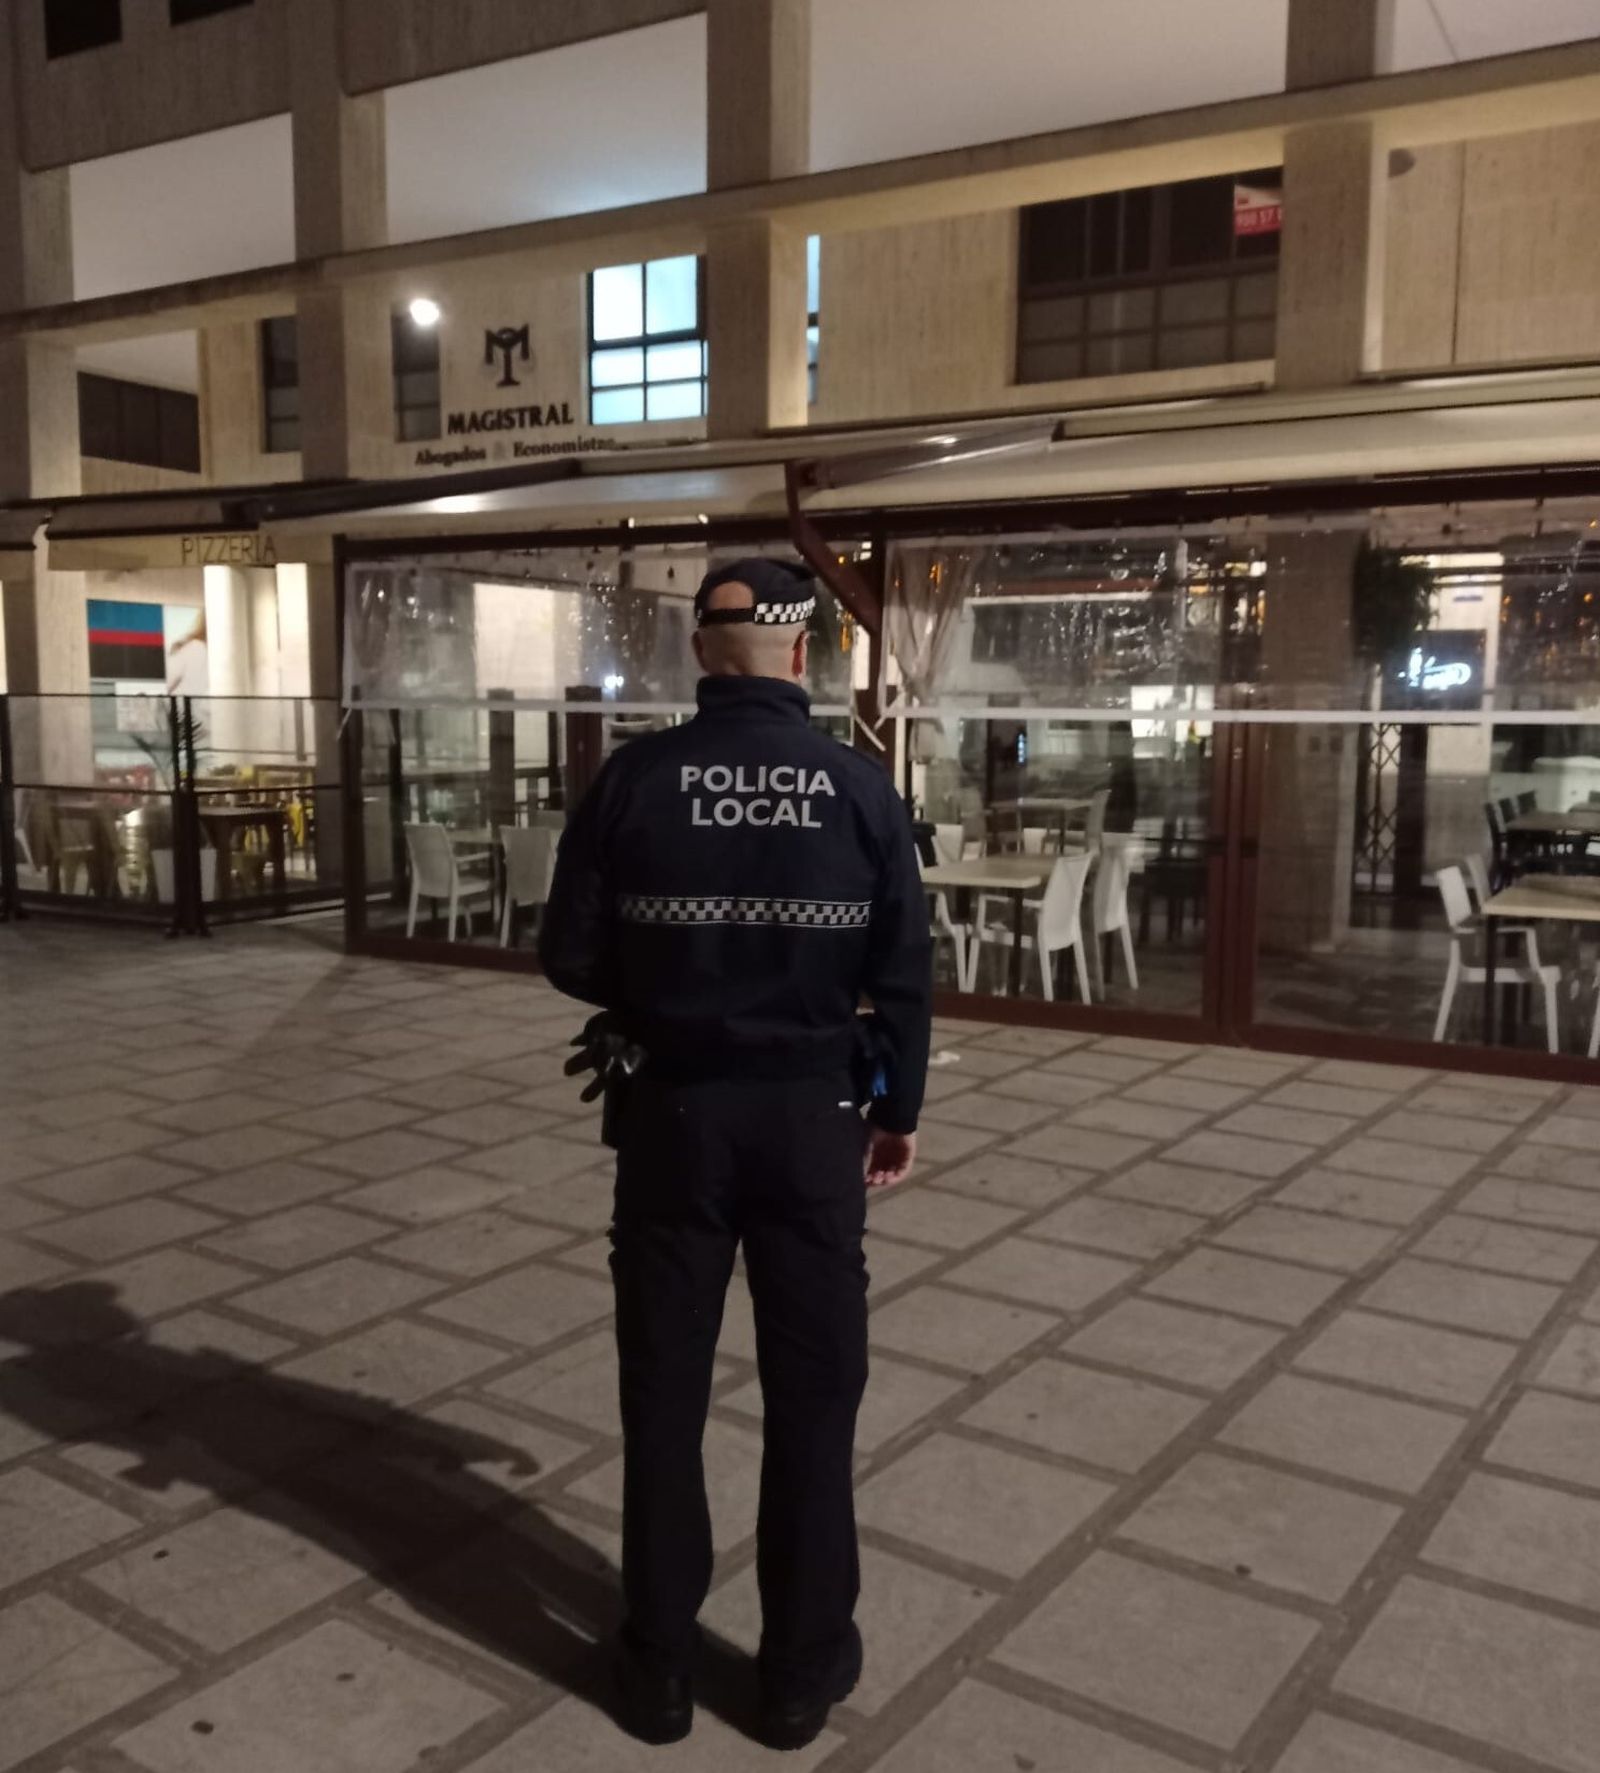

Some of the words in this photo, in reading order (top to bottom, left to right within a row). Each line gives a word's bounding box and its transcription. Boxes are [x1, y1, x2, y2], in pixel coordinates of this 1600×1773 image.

[447, 403, 574, 435] MAGISTRAL
[415, 446, 487, 467] Abogados
[181, 535, 276, 565] PIZZERIA
[680, 765, 836, 797] POLICIA
[692, 798, 822, 829] LOCAL
